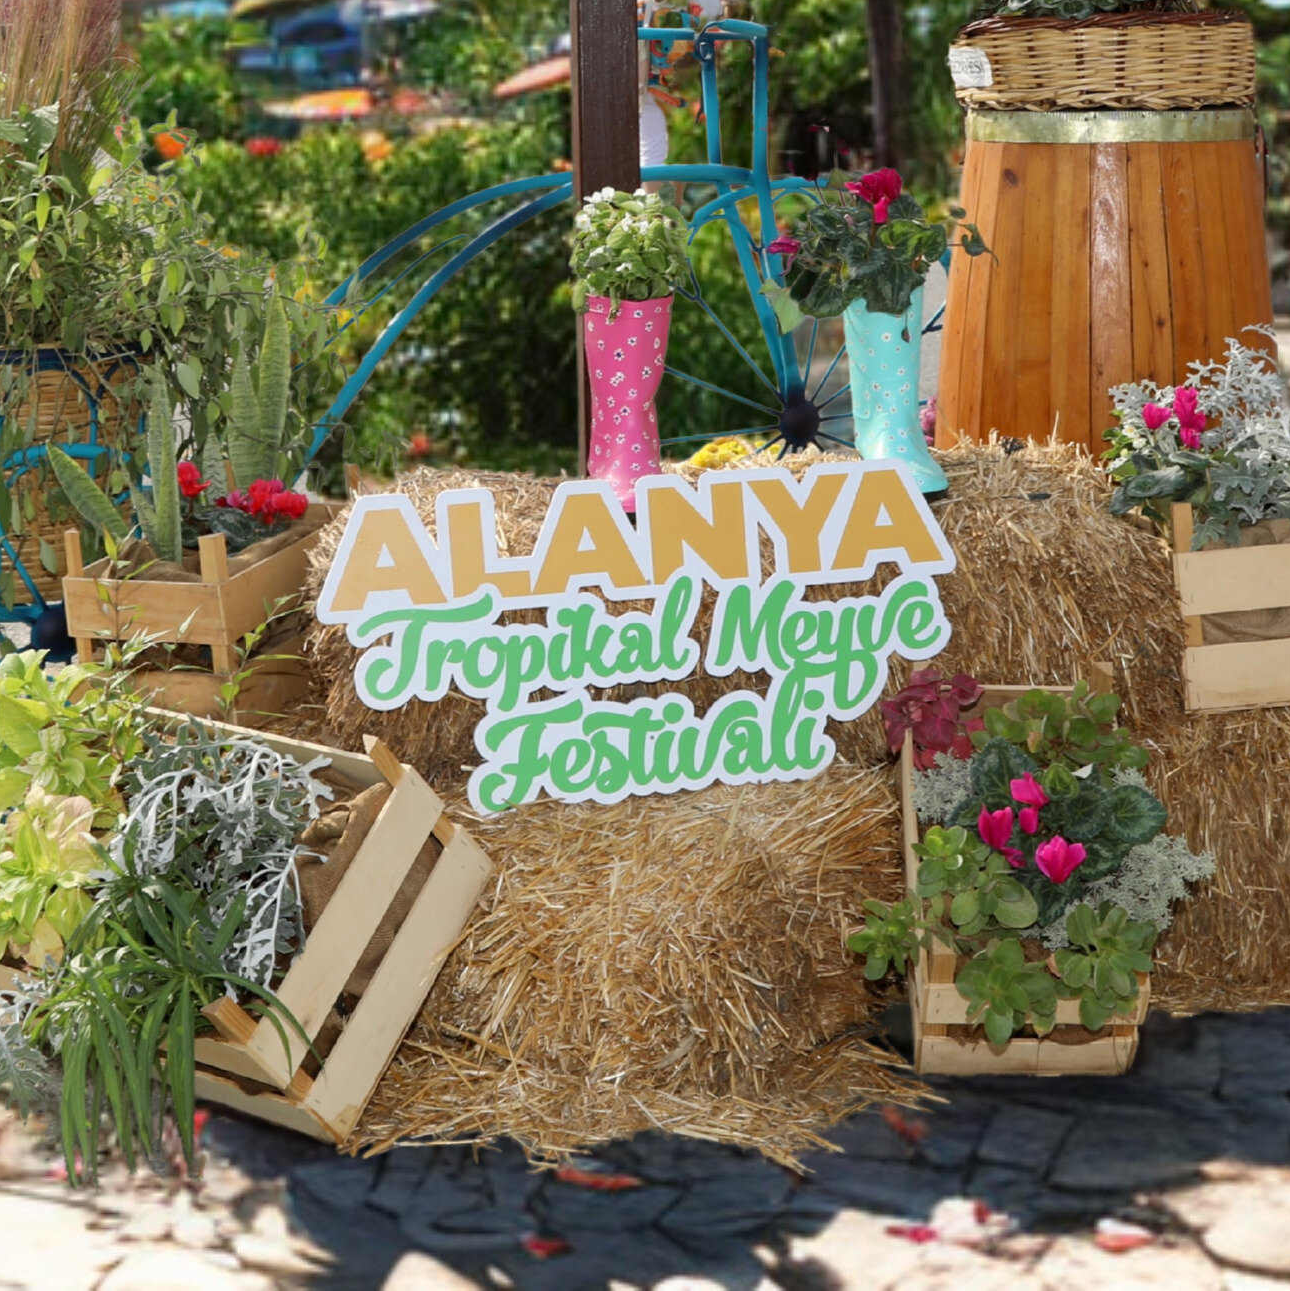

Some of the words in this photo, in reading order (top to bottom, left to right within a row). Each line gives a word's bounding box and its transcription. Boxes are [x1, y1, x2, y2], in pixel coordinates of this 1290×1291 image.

[329, 469, 944, 612] ALANYA
[356, 575, 693, 712] Tropikal
[714, 578, 943, 711] Meyve
[478, 665, 827, 812] Festivali
